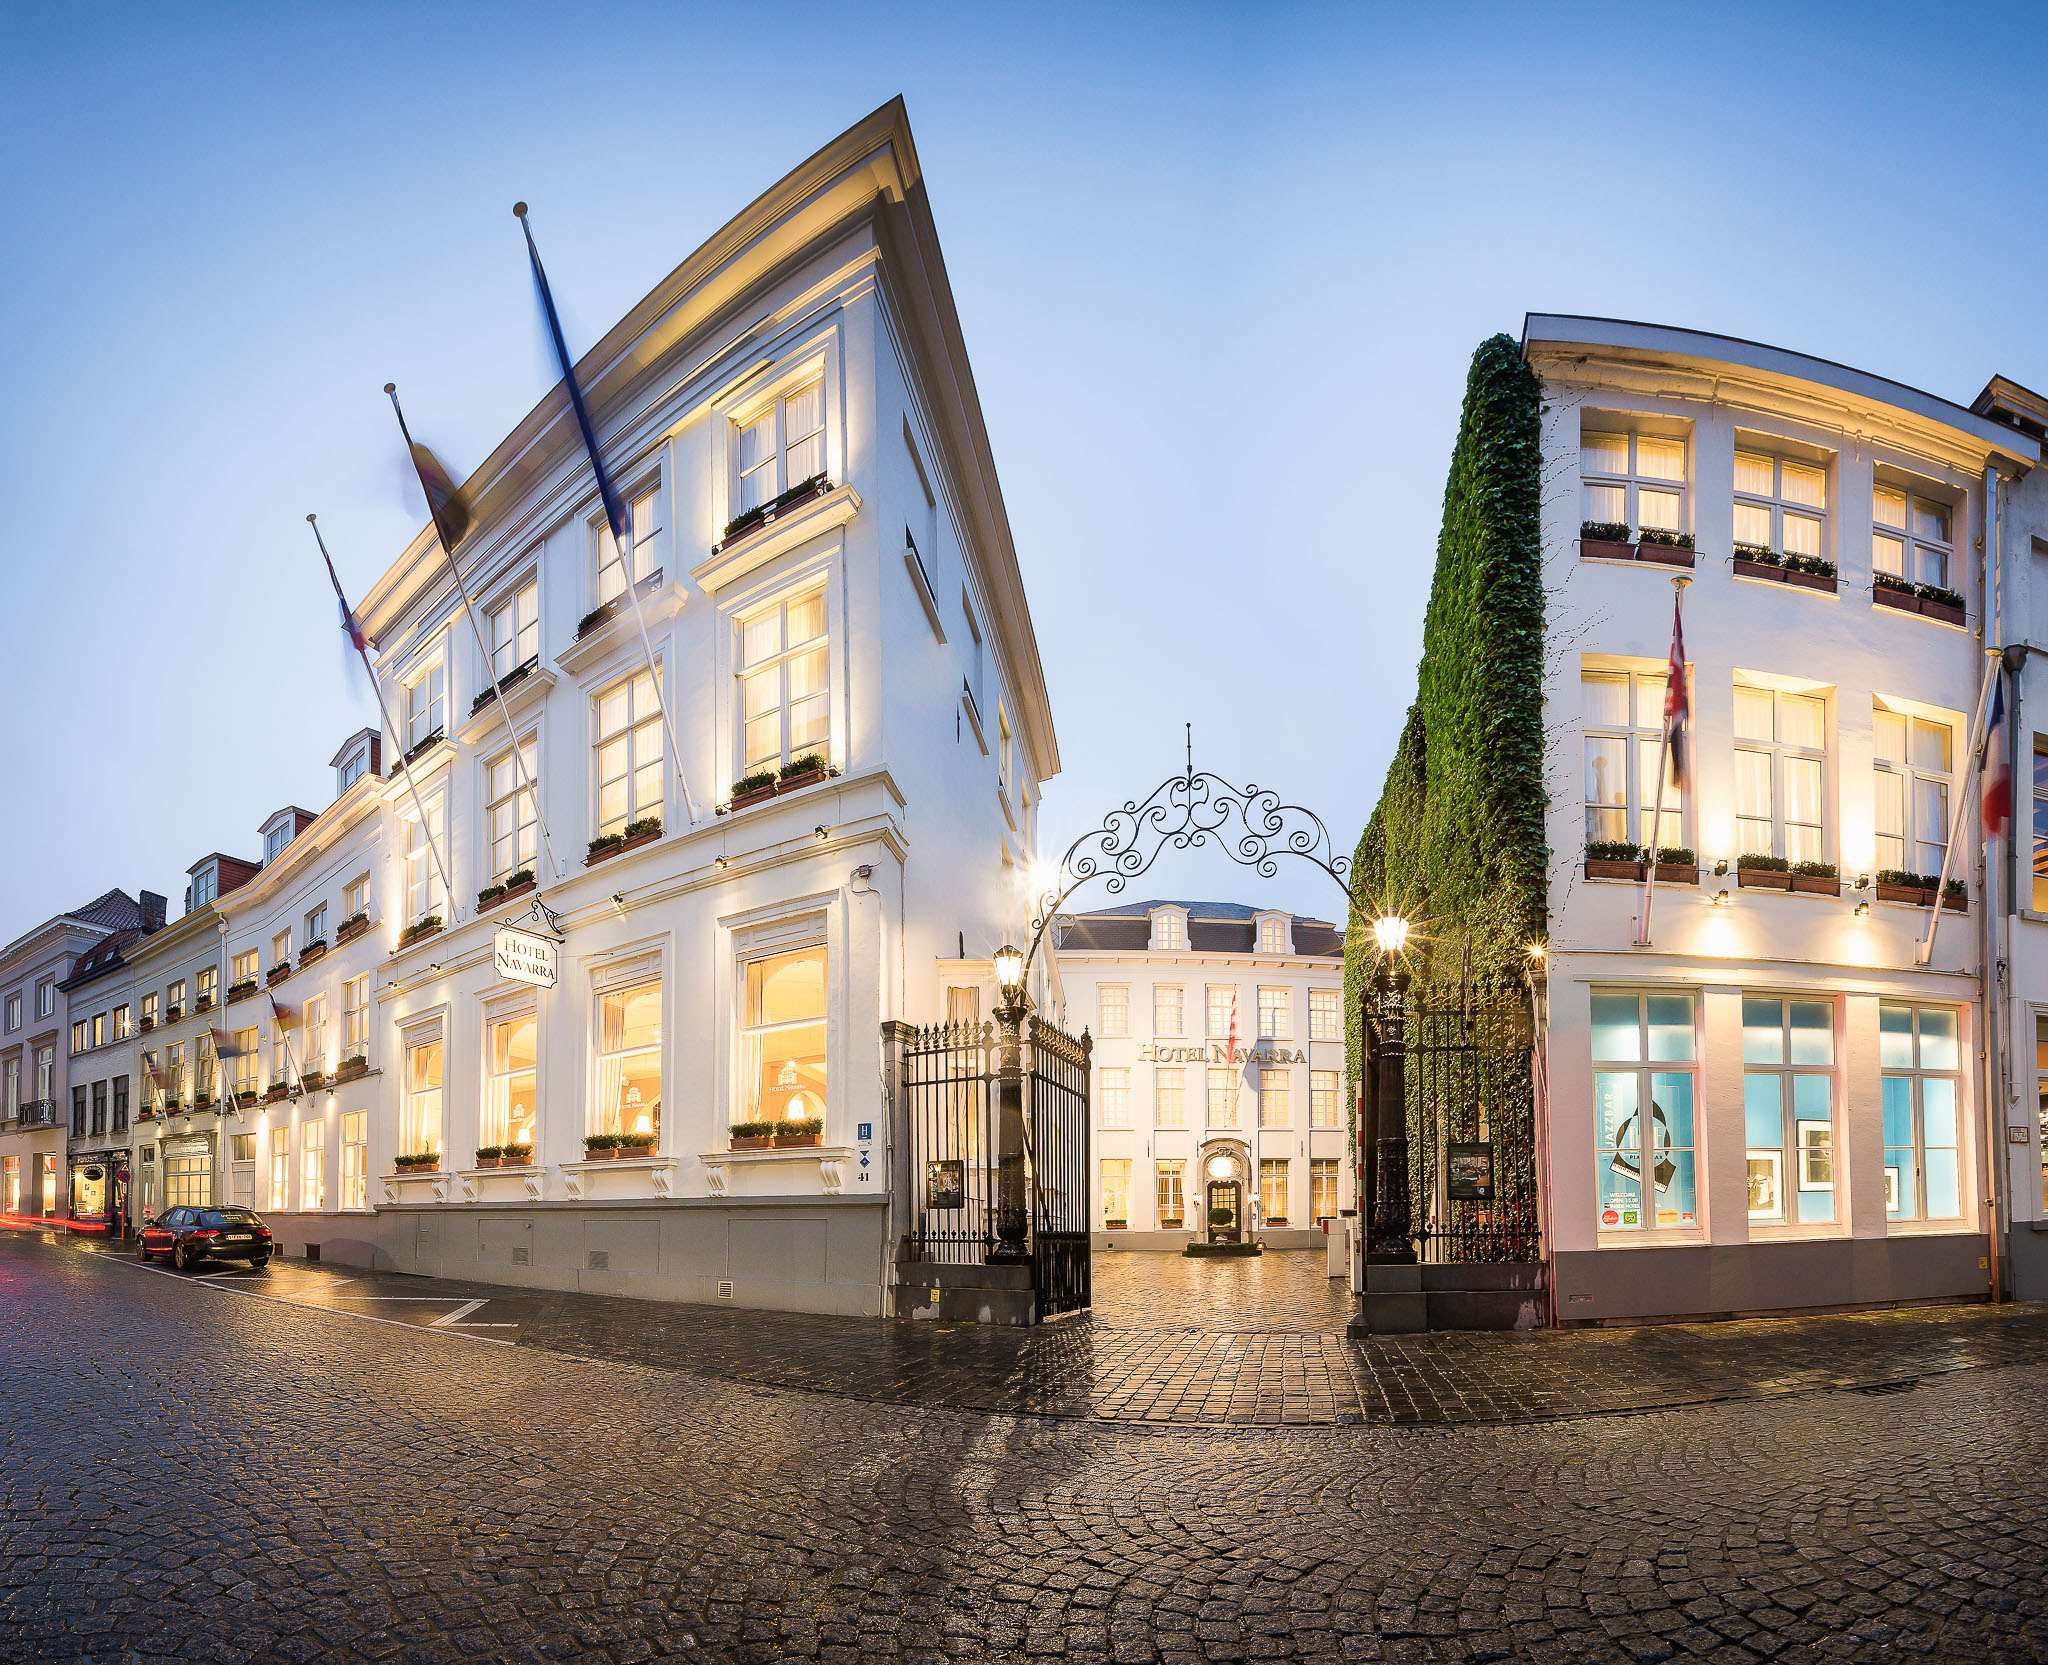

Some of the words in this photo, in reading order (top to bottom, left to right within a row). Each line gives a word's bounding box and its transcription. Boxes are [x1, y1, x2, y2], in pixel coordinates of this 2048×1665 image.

[504, 938, 549, 962] HOTEL
[497, 953, 555, 980] NAVARRA
[1137, 1042, 1210, 1063] HOTEL
[1211, 1044, 1308, 1064] NAVARRA
[857, 1172, 870, 1182] 41
